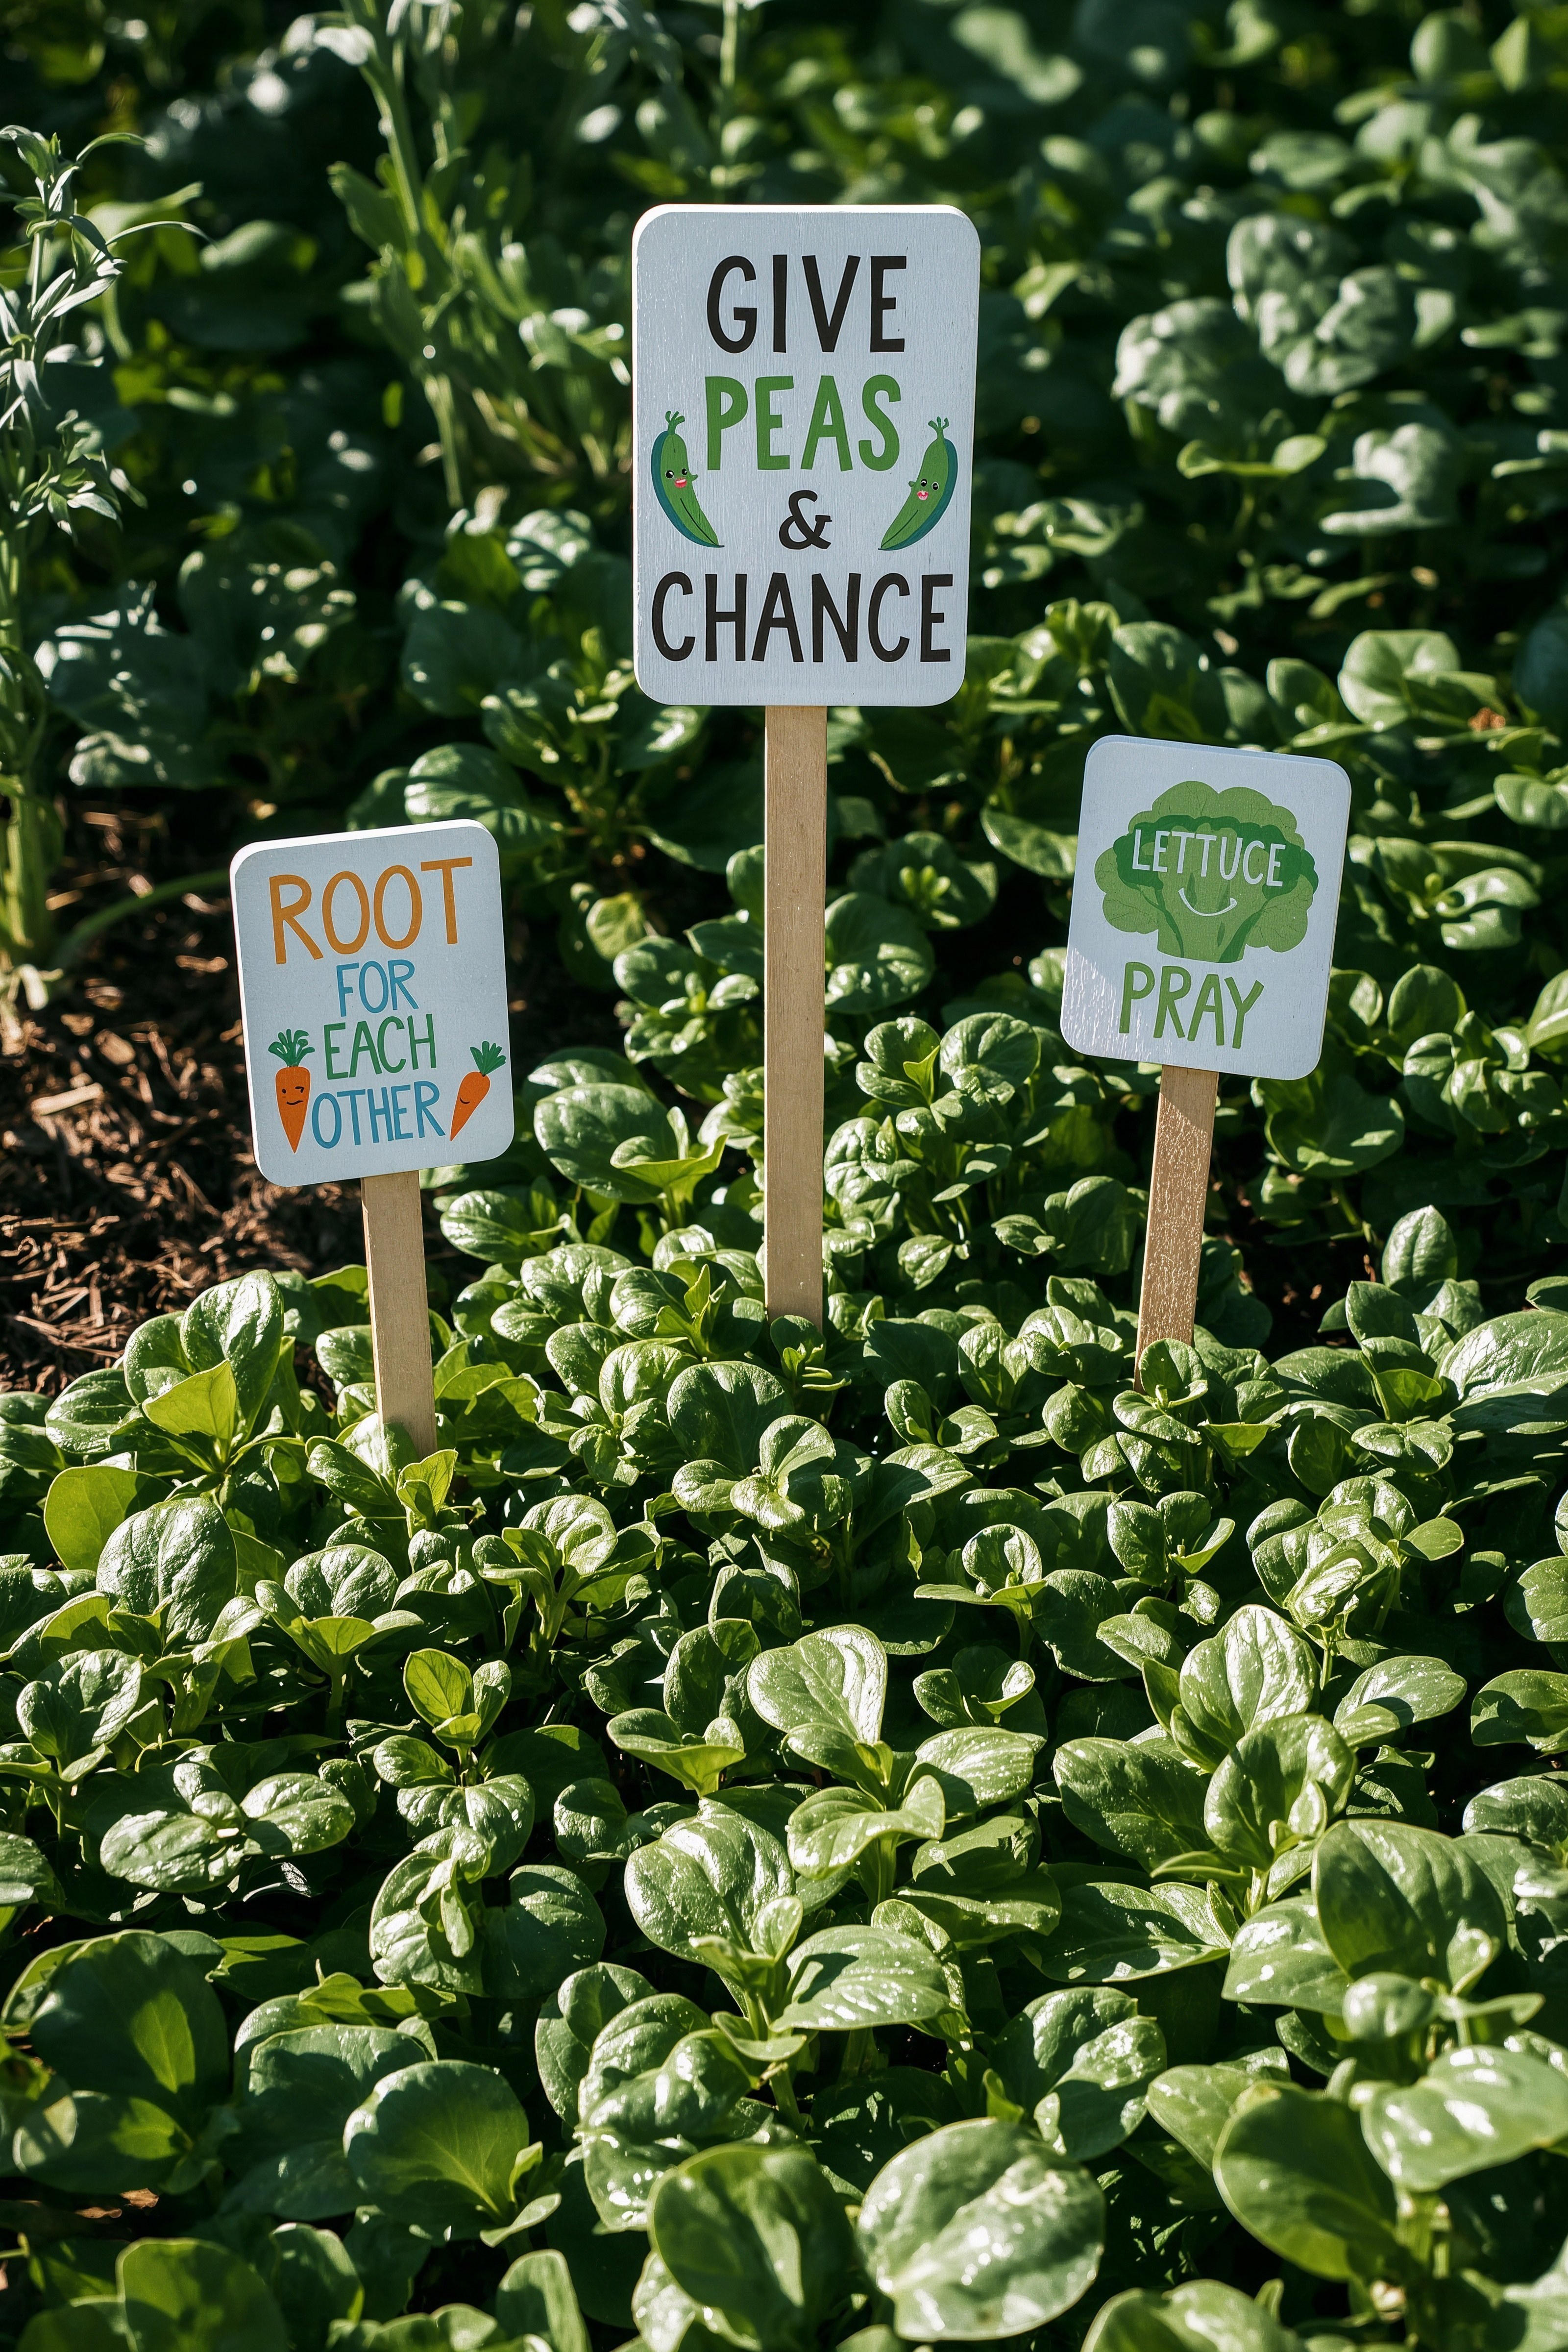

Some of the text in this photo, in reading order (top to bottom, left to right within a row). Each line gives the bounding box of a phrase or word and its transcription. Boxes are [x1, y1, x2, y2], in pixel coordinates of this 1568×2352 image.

[707, 254, 907, 354] GIVE
[705, 374, 901, 472] PEAS
[779, 490, 832, 550] &
[652, 571, 954, 663] CHANCE
[1131, 829, 1286, 887] LETTUCE
[269, 857, 472, 964] ROOT
[336, 959, 419, 1017] FOR
[1119, 962, 1264, 1049] PRAY
[324, 1014, 437, 1080] EACH
[312, 1081, 446, 1149] OTHER
